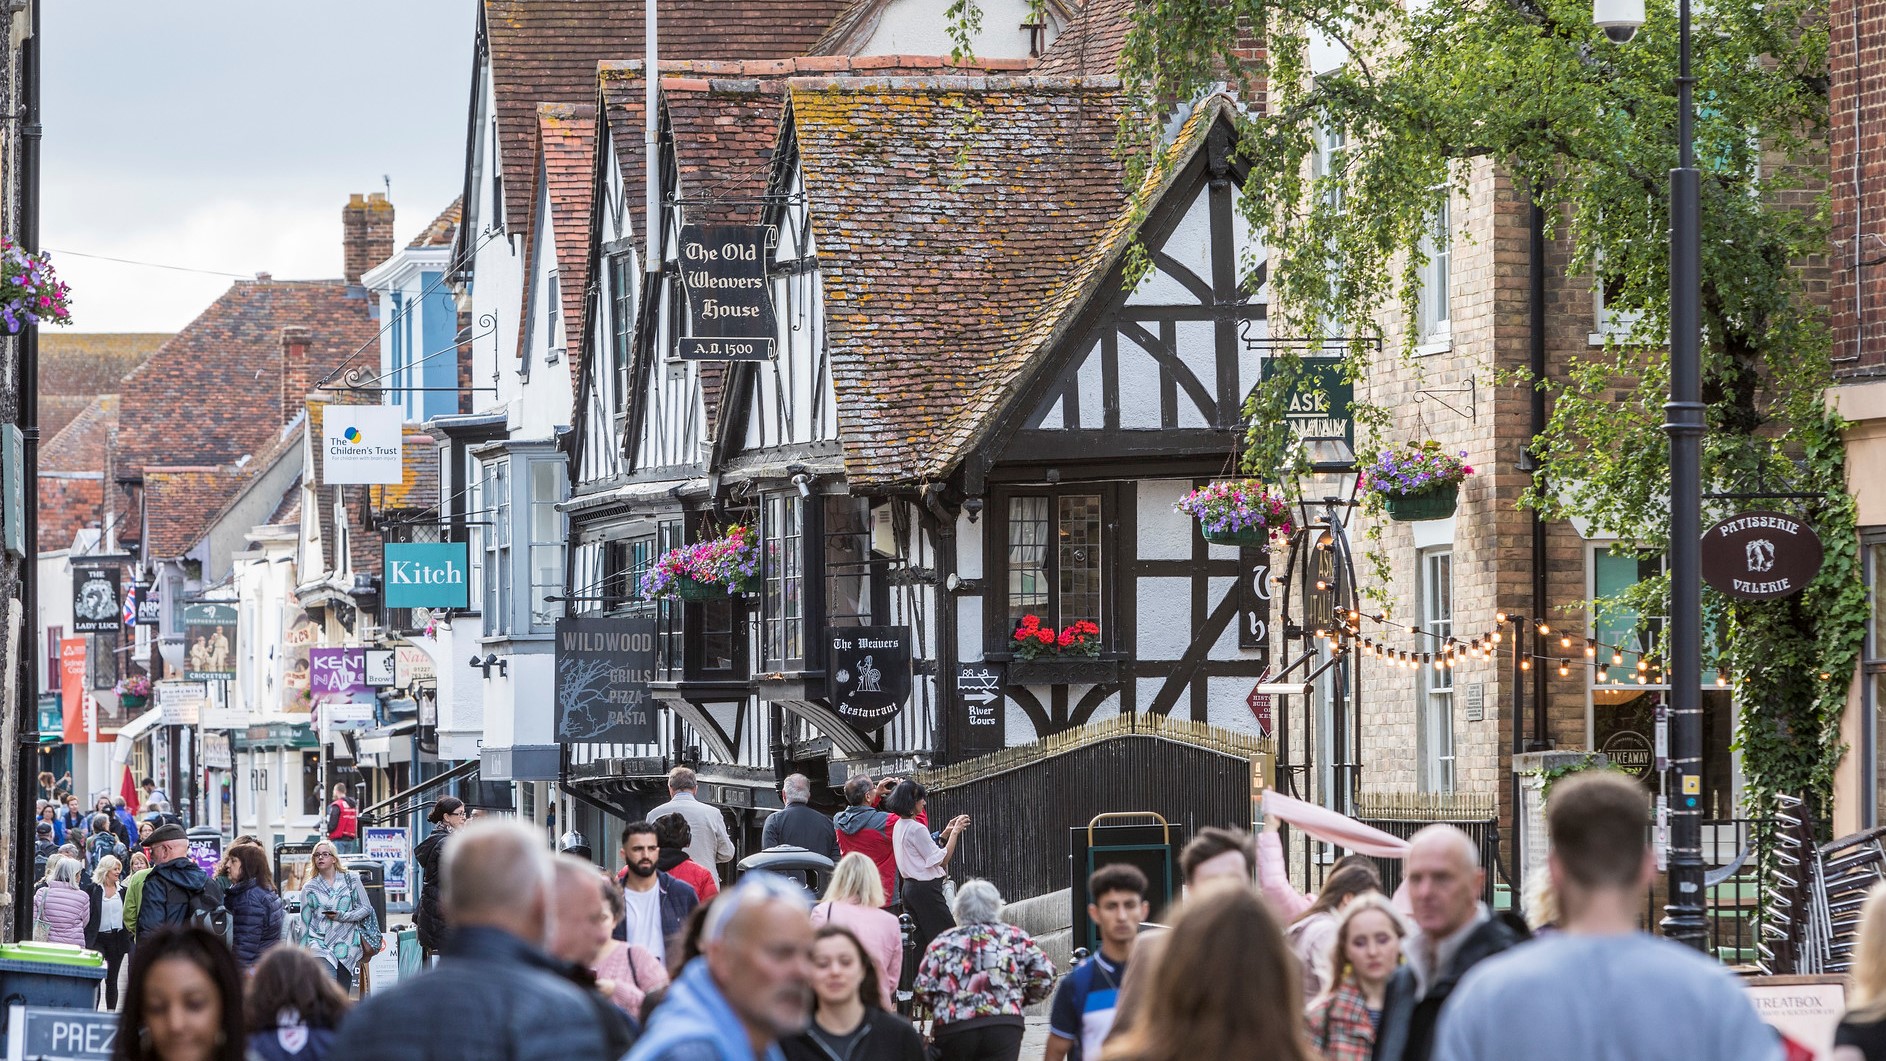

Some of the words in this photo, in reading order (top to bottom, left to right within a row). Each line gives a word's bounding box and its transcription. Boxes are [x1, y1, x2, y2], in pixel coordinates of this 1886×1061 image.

[686, 242, 718, 263] The
[722, 242, 757, 260] Old
[688, 271, 763, 289] Weavers
[701, 298, 760, 319] House
[694, 343, 722, 354] A.D.
[725, 344, 753, 356] 1500
[1289, 392, 1327, 411] ASK
[330, 446, 373, 455] Children's
[375, 446, 397, 455] Trust
[1720, 516, 1800, 537] PATISSERIE
[389, 560, 463, 584] Kitch
[1733, 578, 1791, 594] VALERIE
[76, 622, 97, 630] LADY
[98, 622, 119, 630] LUCK
[563, 632, 652, 652] WILDWOOD
[833, 638, 852, 651] The
[858, 637, 899, 649] Weavers
[610, 669, 651, 683] GRILLS
[609, 690, 643, 704] PIZZA
[838, 702, 898, 718] Restaurant
[968, 705, 994, 715] River
[608, 711, 646, 725] PASTA
[969, 715, 996, 725] Tours
[1607, 752, 1649, 764] TAKEAWAY
[1754, 997, 1824, 1009] TREATBOX
